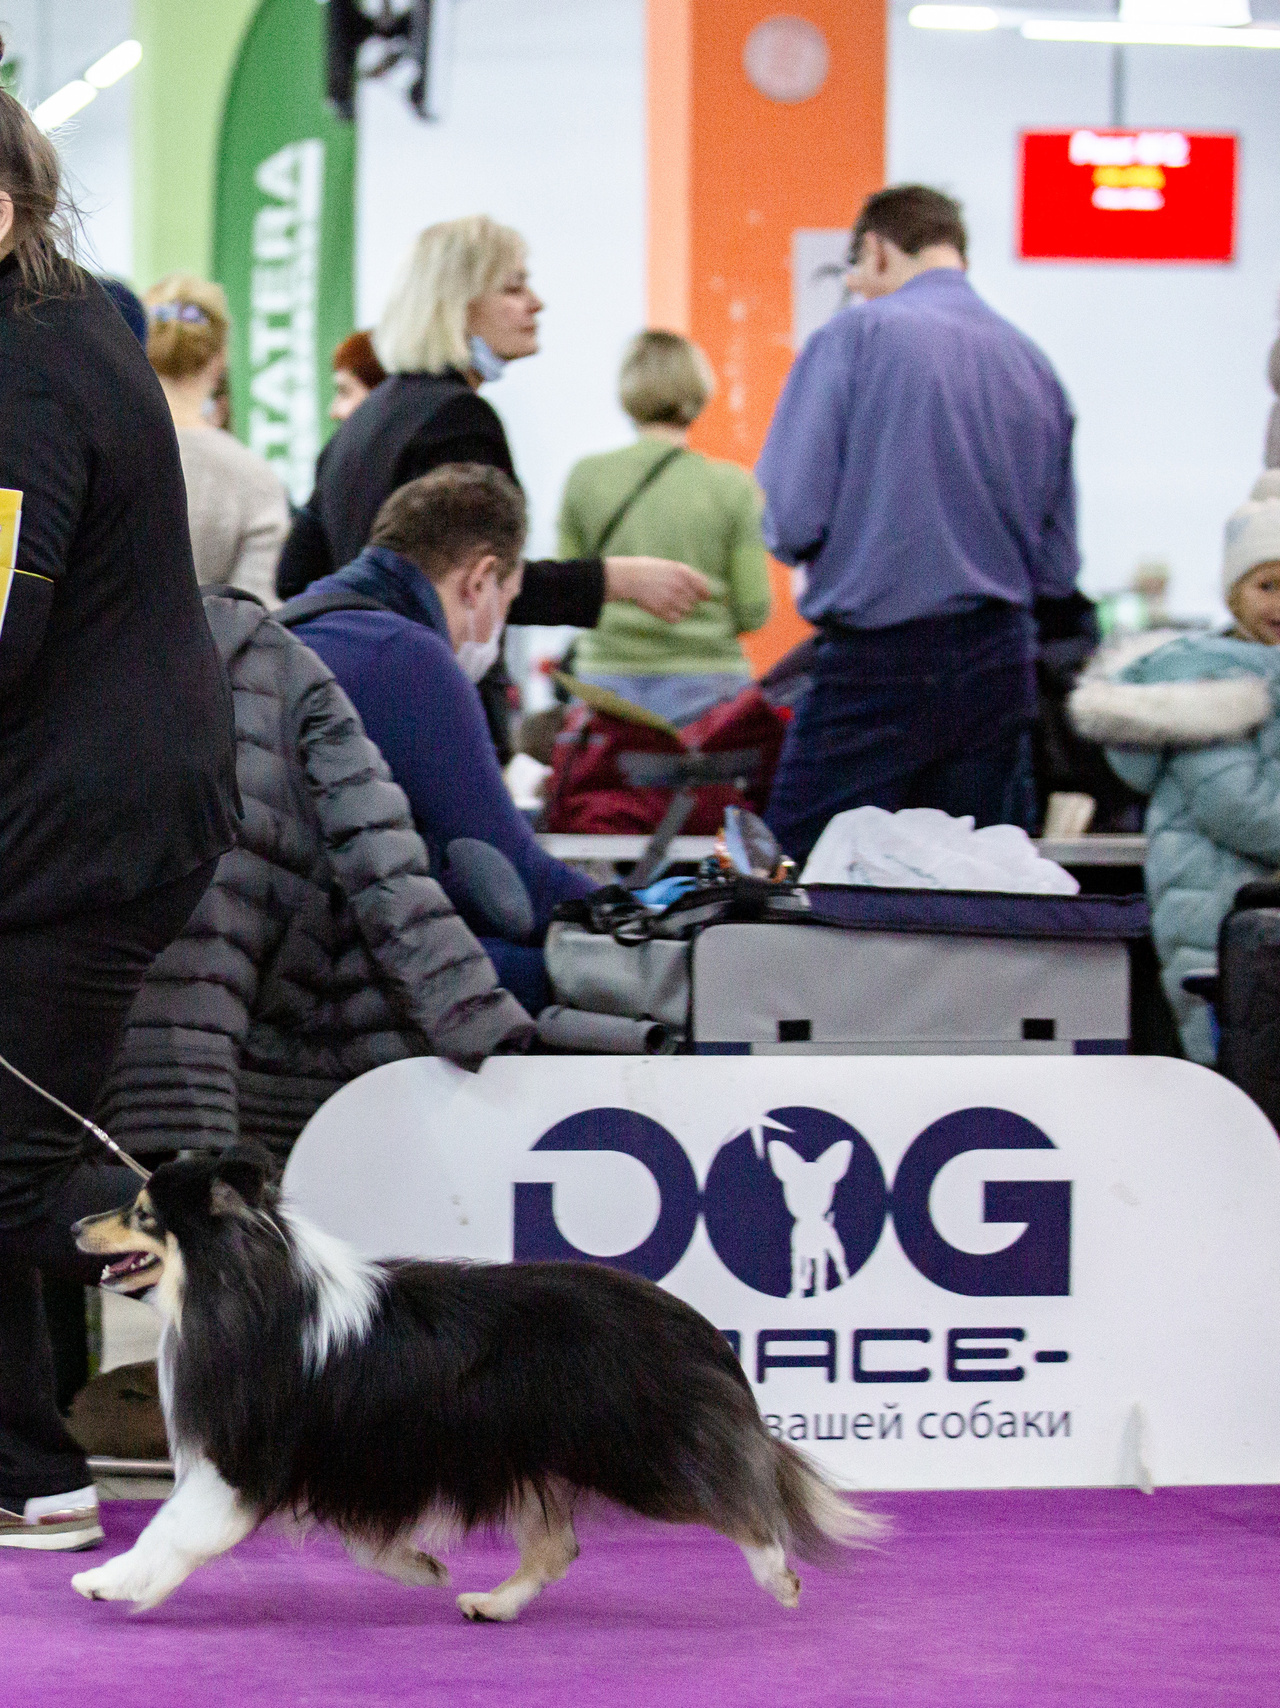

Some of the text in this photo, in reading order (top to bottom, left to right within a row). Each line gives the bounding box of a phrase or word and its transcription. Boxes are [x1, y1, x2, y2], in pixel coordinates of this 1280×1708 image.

[512, 1105, 1073, 1299] DOG
[718, 1328, 1069, 1384] ACE-
[918, 1399, 1071, 1440] собаки
